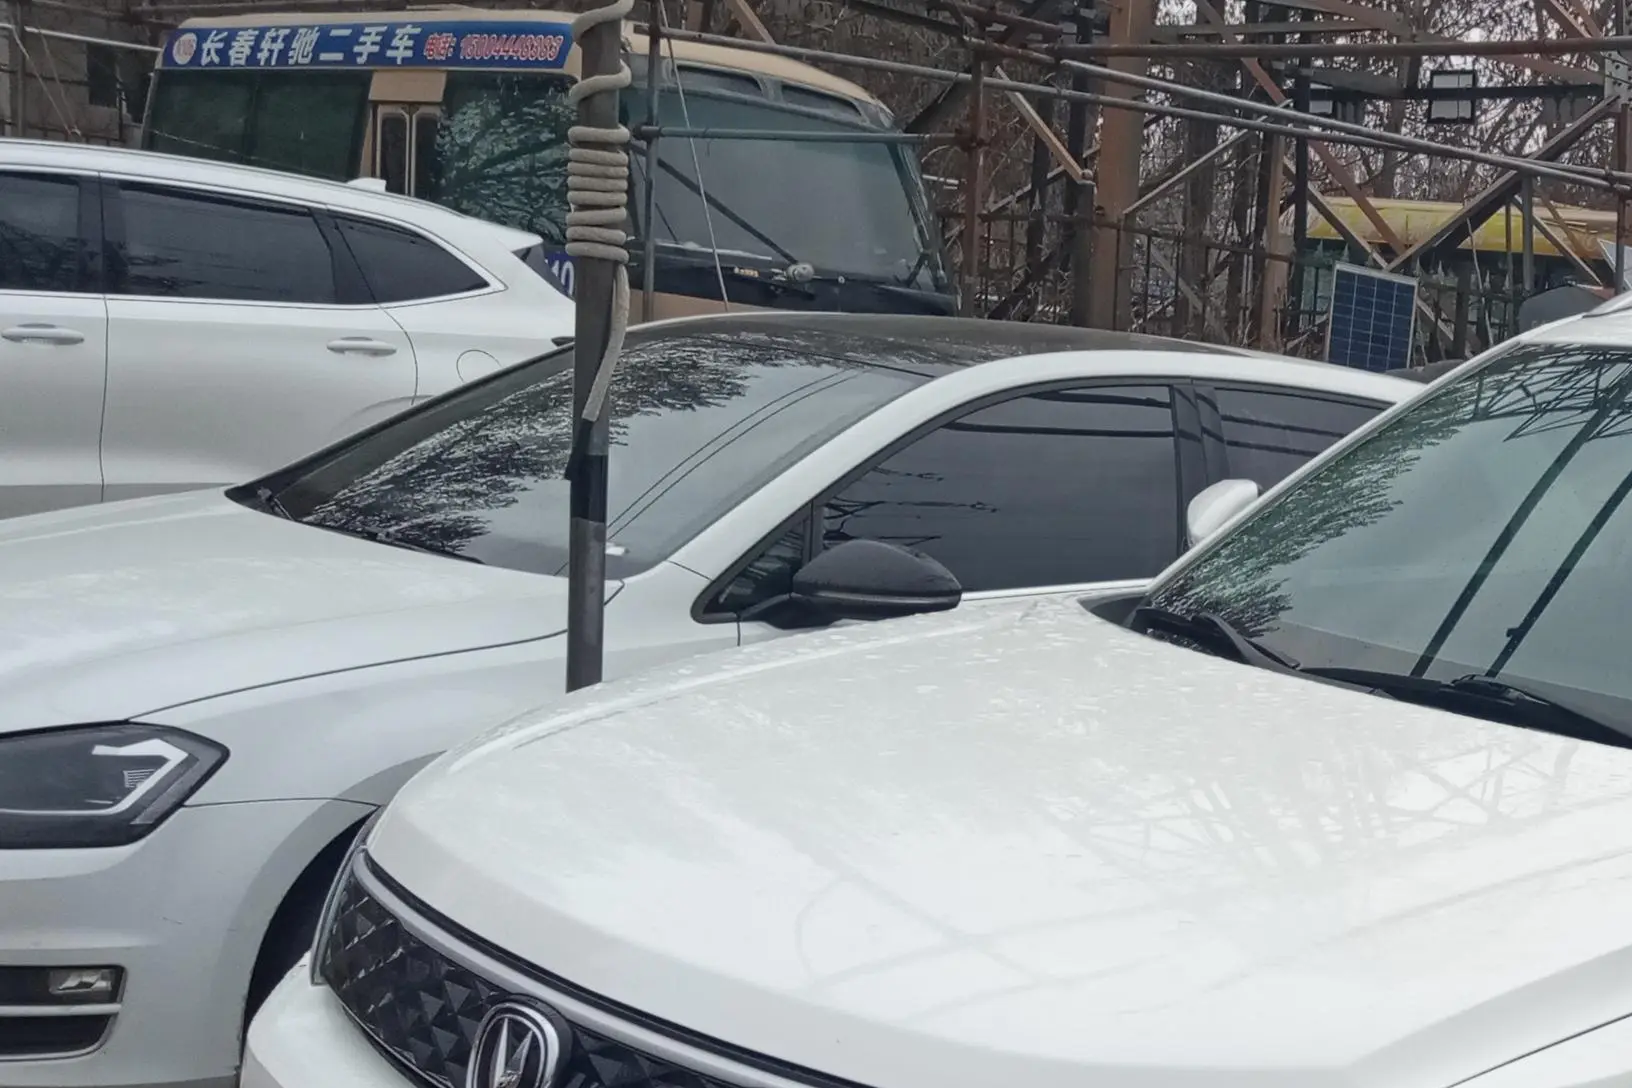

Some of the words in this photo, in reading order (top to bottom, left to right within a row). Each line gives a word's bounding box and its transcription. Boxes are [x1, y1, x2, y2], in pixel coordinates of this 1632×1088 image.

[201, 25, 421, 66] 长春轩驰二手车
